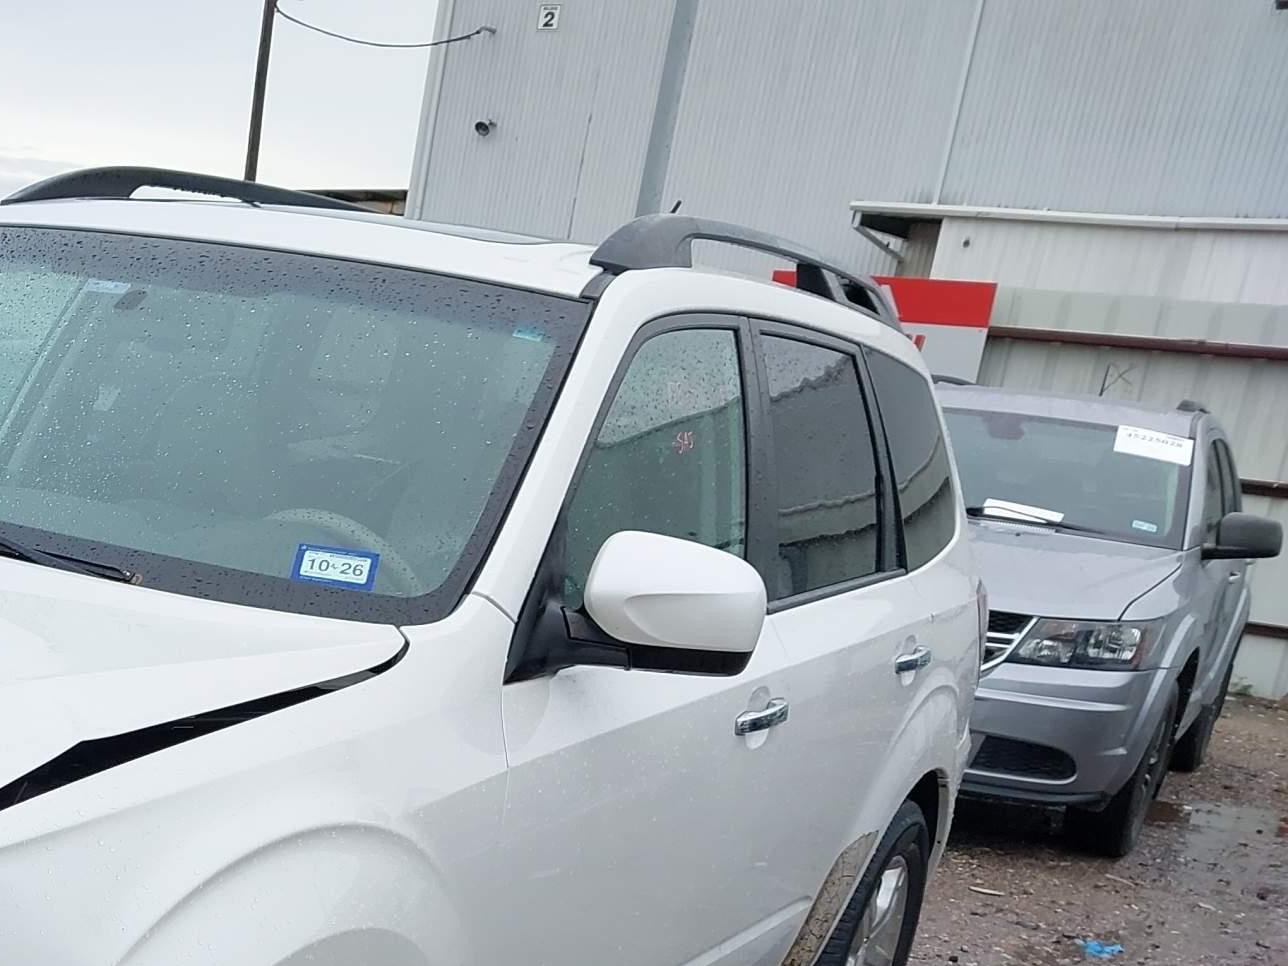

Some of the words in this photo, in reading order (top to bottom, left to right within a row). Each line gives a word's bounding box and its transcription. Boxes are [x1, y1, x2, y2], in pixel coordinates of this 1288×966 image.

[542, 11, 555, 27] 2
[307, 558, 330, 572] 10
[339, 562, 364, 577] 26
